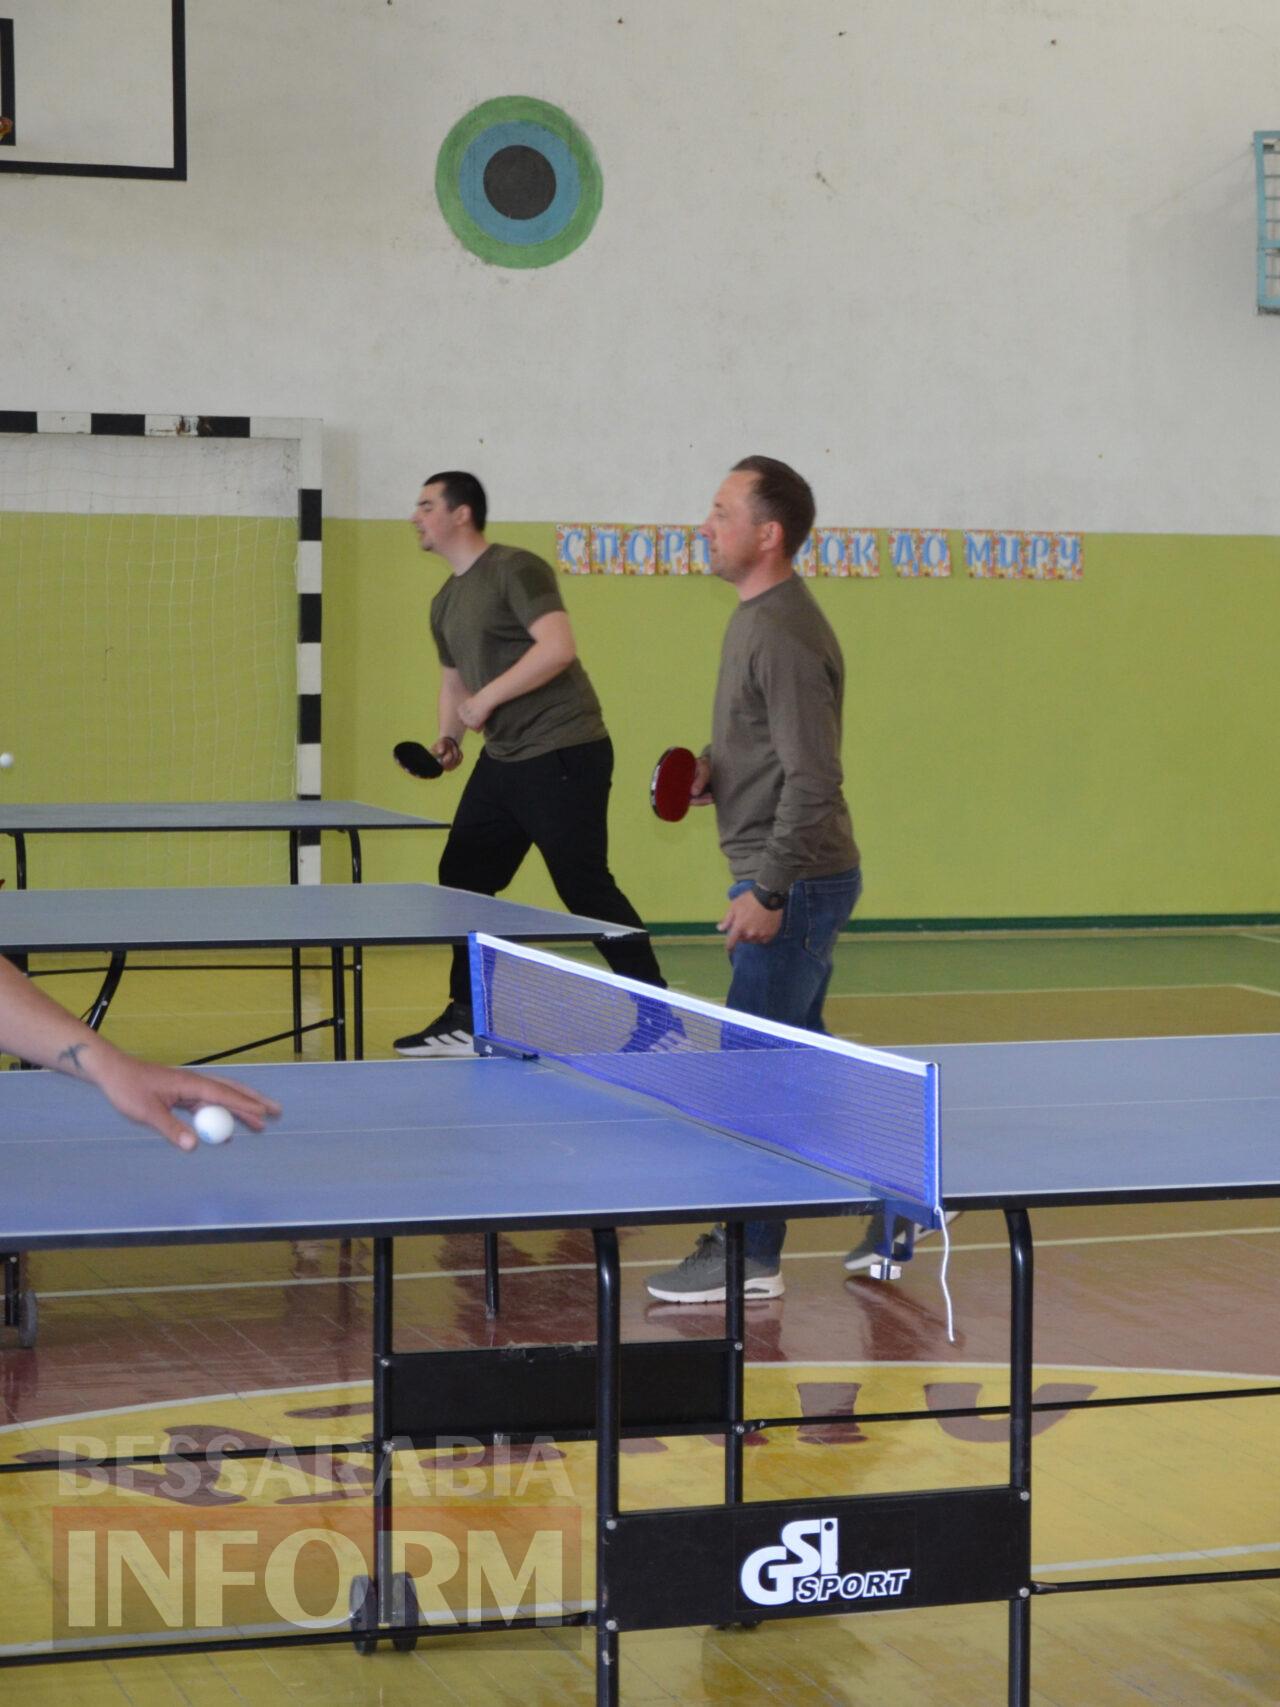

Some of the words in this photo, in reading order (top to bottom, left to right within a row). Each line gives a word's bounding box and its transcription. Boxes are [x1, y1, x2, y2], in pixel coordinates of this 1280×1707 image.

[893, 532, 948, 573] ДО
[964, 534, 1080, 570] МИРУ
[795, 1568, 911, 1603] SPORT
